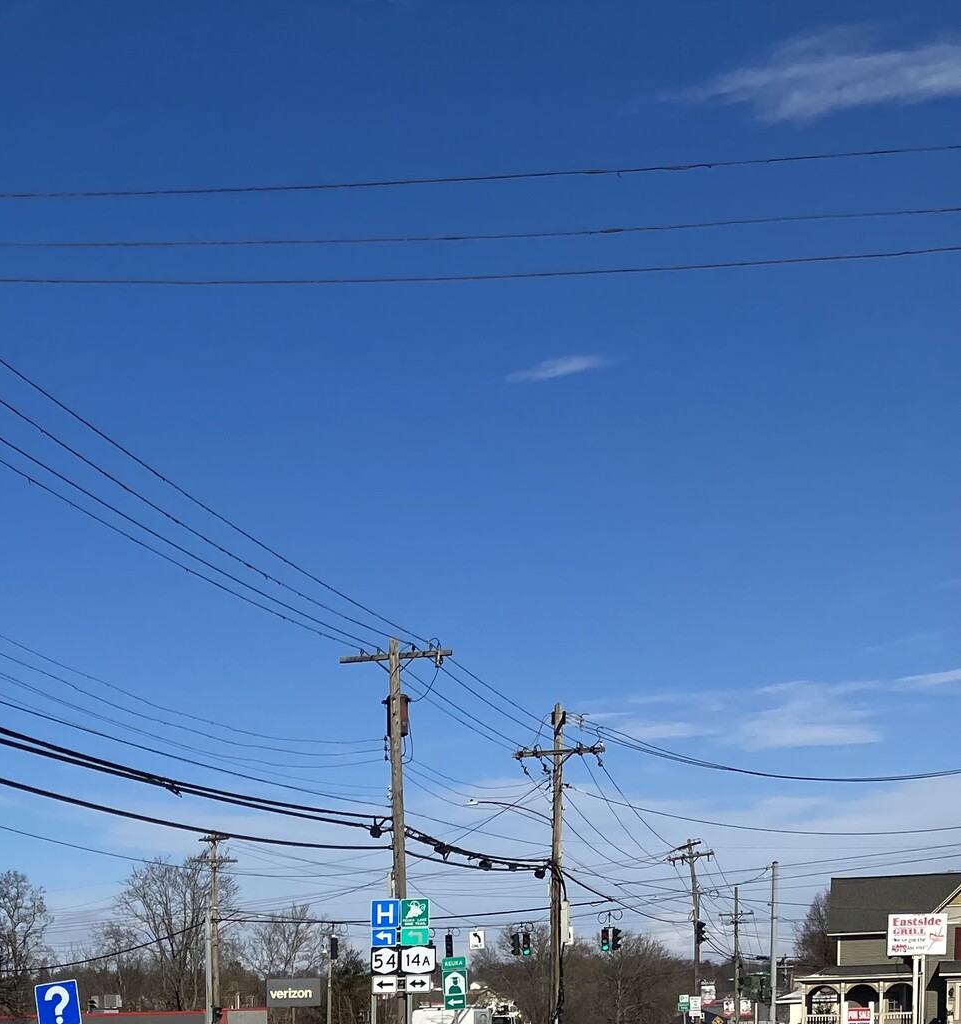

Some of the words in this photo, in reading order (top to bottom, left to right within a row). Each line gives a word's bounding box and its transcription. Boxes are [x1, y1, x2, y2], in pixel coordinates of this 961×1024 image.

[377, 904, 393, 924] H
[892, 917, 942, 926] Eastside
[374, 954, 396, 969] 54
[406, 954, 430, 966] 14A
[270, 988, 312, 999] verizon
[849, 1010, 858, 1020] FOR
[859, 1010, 870, 1020] SALE
